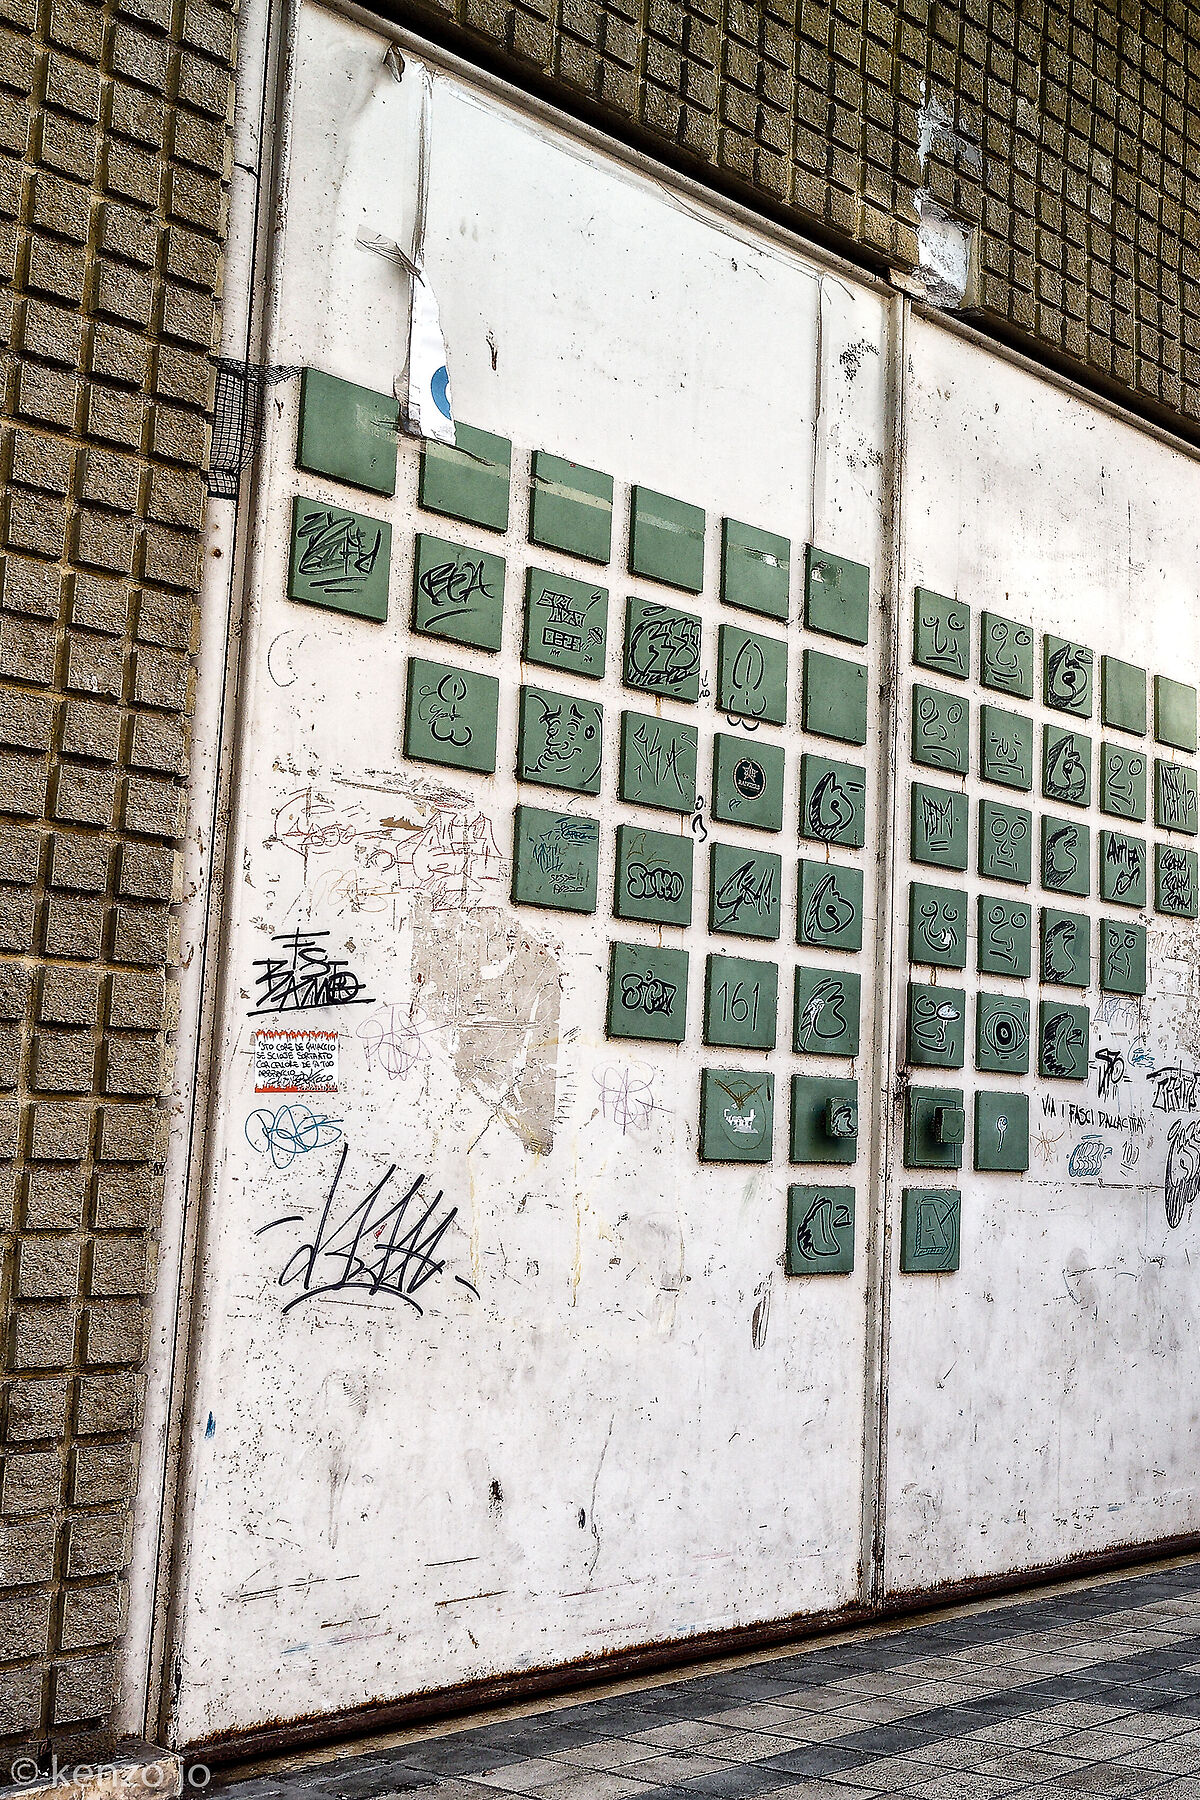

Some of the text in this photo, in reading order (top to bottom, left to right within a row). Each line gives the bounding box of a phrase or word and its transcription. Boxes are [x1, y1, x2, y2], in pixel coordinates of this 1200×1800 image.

[717, 981, 763, 1031] 161
[1042, 1093, 1057, 1118] VIA
[1068, 1104, 1095, 1125] FASCI
